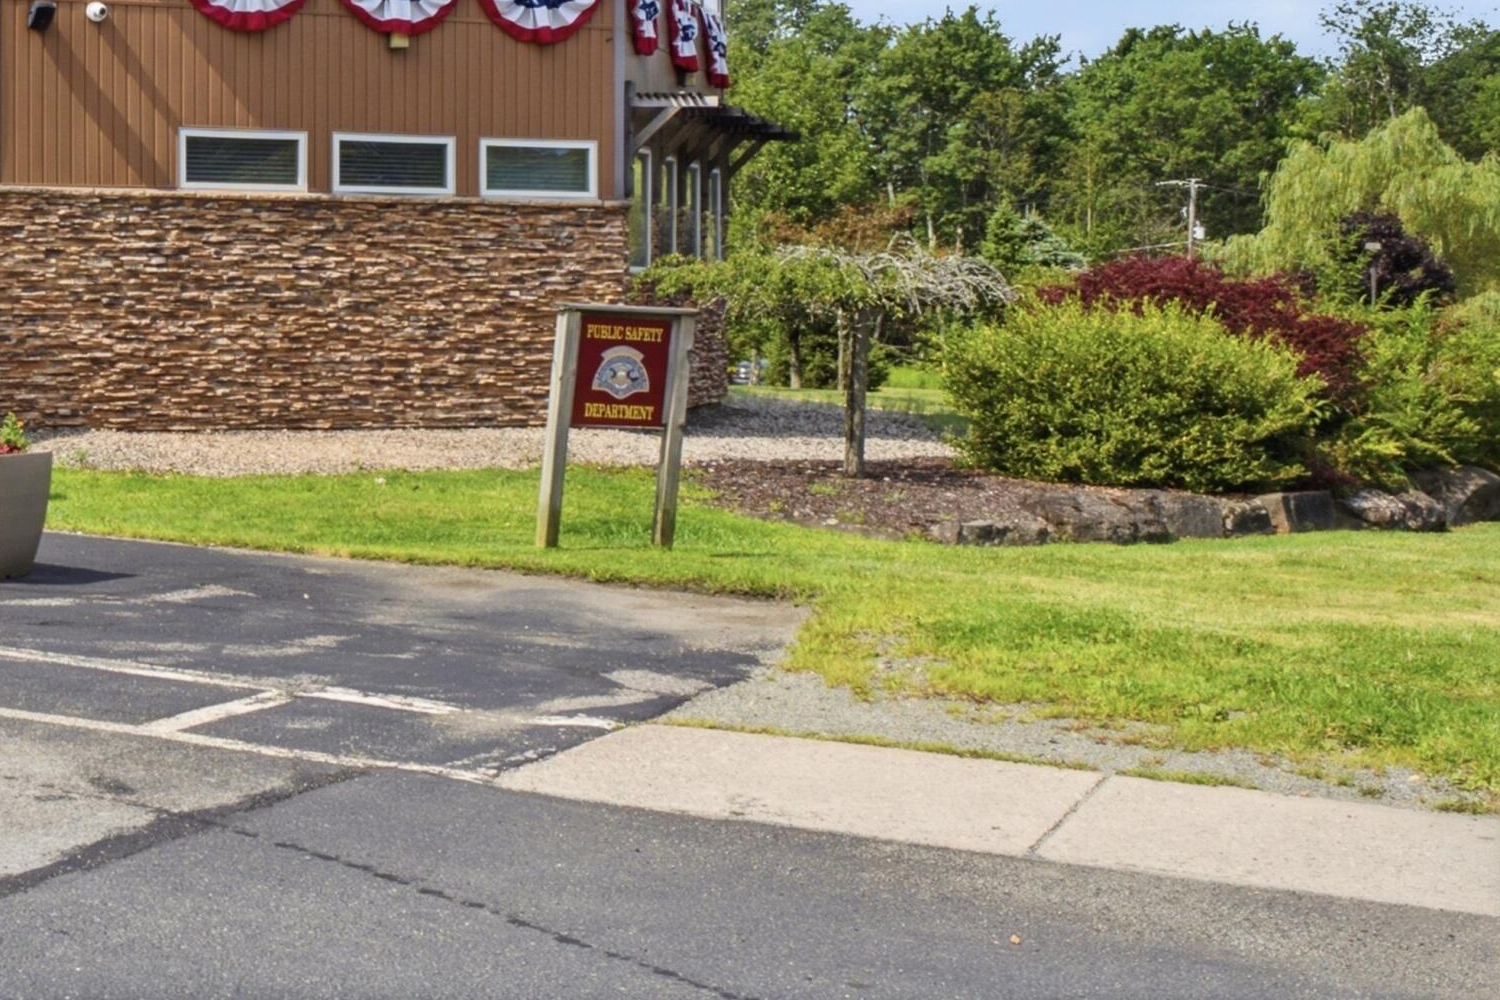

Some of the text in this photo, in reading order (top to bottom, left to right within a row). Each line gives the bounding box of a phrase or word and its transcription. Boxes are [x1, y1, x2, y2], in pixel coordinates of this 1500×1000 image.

[587, 324, 664, 342] PUBLIC SAFETY
[584, 403, 655, 420] DEPARTMENT
